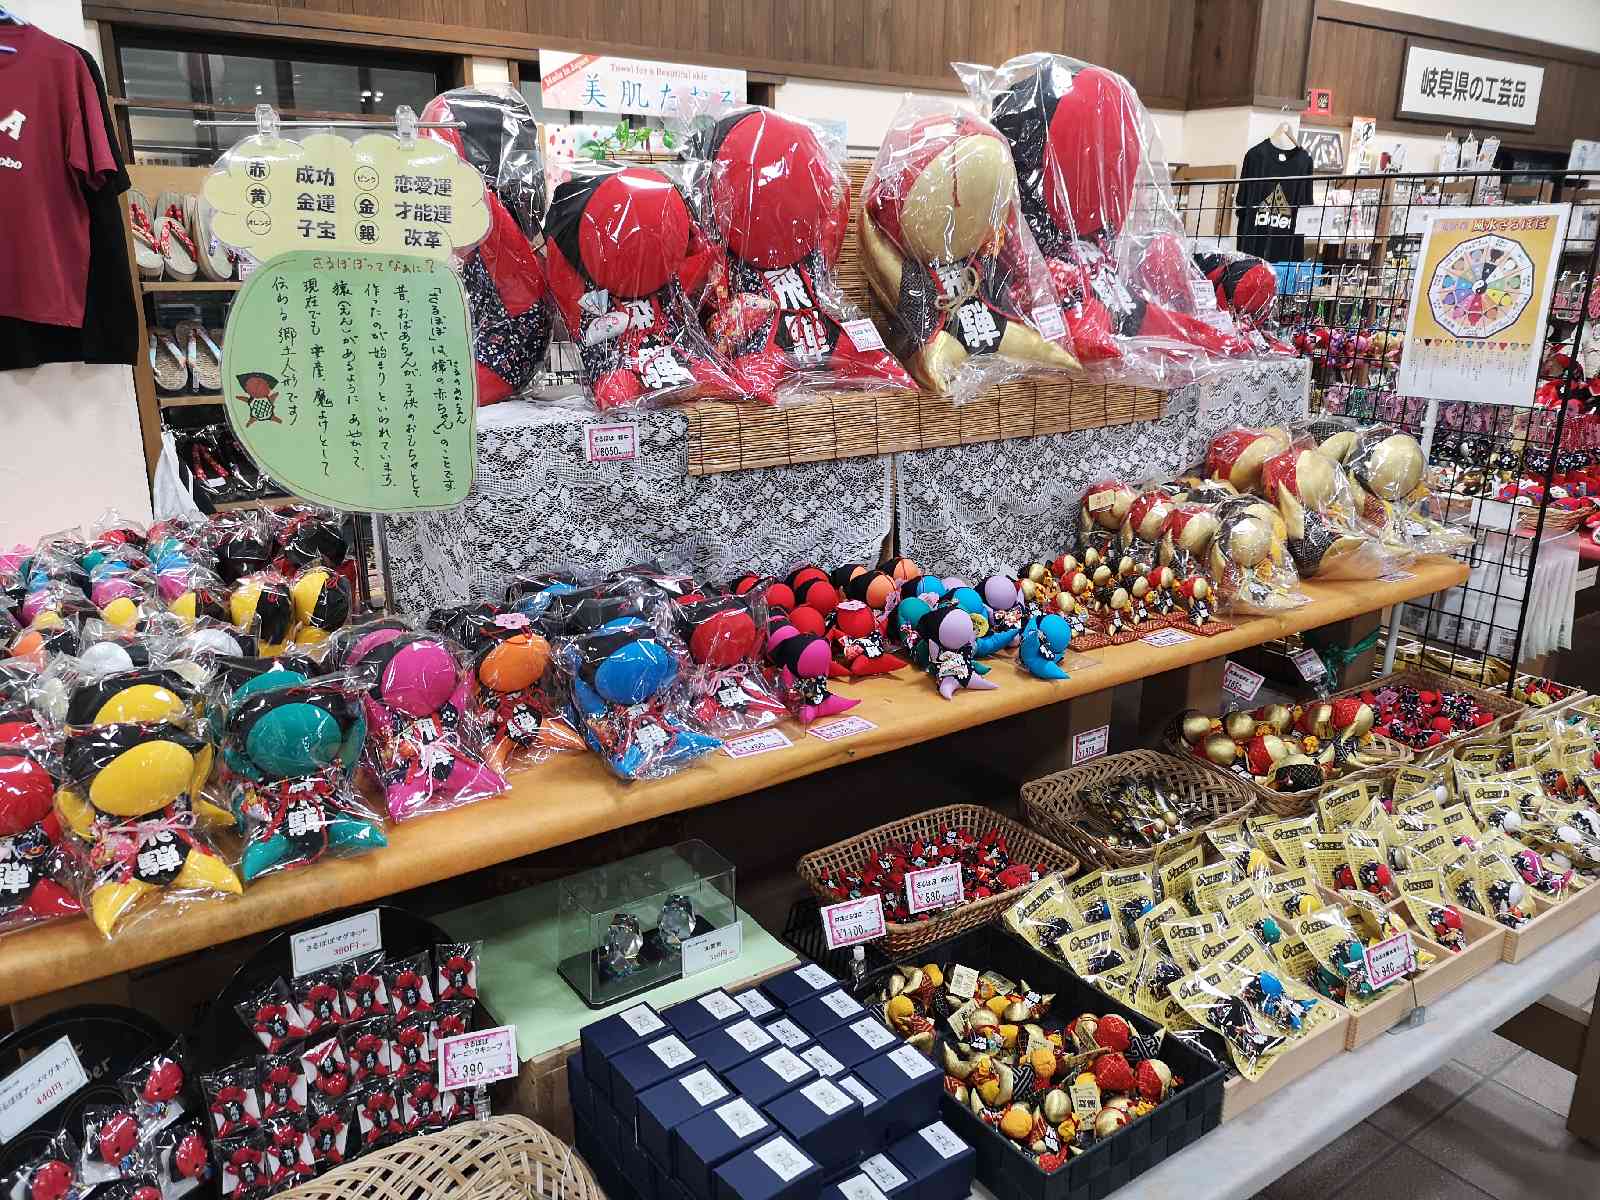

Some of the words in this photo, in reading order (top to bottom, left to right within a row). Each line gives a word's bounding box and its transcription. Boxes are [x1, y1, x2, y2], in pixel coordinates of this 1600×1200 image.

[1420, 67, 1528, 108] 岐阜県の工芸品
[249, 161, 267, 178] 赤
[295, 166, 336, 188] 成功
[356, 174, 377, 184] ピンク
[394, 175, 453, 198] 恋愛運
[250, 187, 268, 206] 黄
[296, 193, 336, 213] 金運
[358, 199, 376, 216] 金
[394, 203, 453, 224] 才能運
[247, 217, 272, 229] オレンジ
[297, 219, 337, 240] 子宝
[358, 225, 376, 242] 銀
[404, 228, 443, 249] 改革
